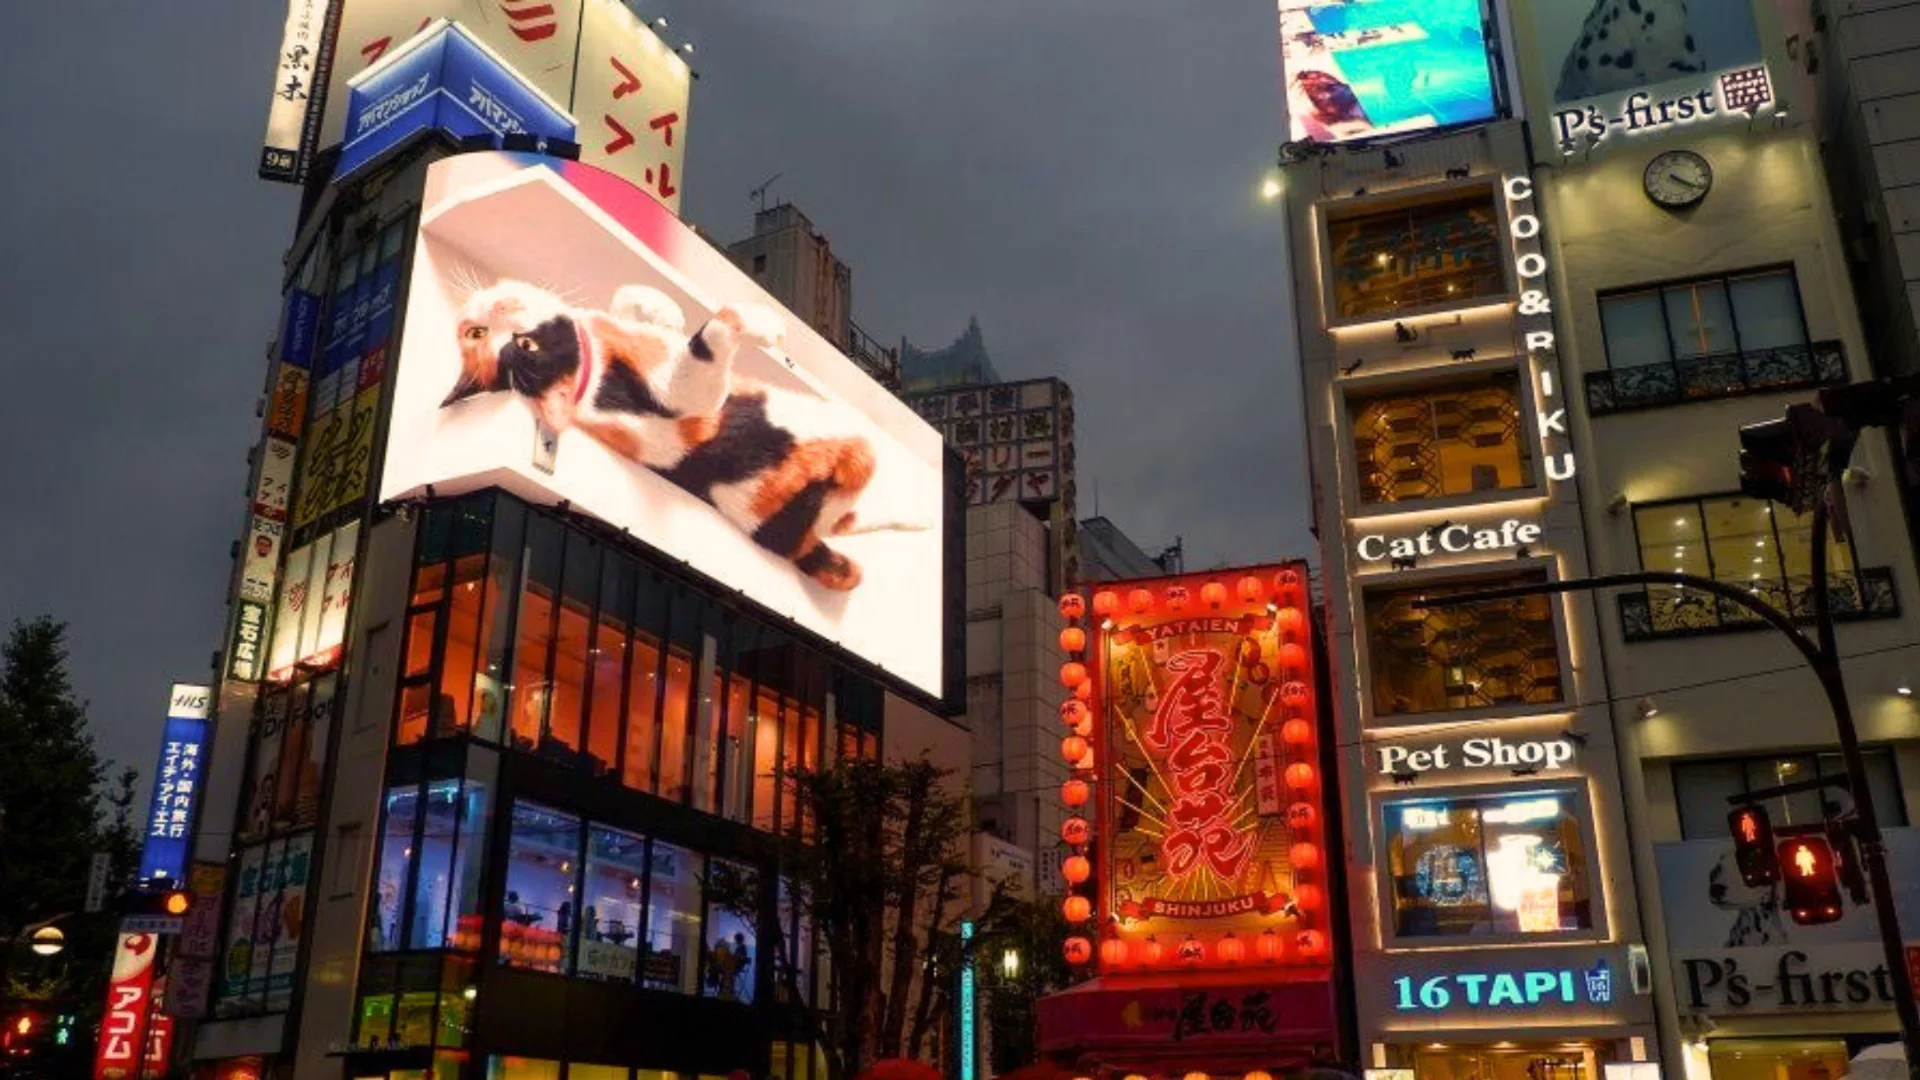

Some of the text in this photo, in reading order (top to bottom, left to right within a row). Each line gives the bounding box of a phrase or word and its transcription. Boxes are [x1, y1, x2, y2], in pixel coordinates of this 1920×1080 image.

[1357, 518, 1542, 563] Cat Cafe
[1145, 618, 1240, 641] YATAIEN
[1377, 737, 1573, 774] Pet Shop
[1153, 896, 1255, 917] SHINJUKU
[1393, 969, 1575, 1010] 16 TAPI
[1681, 950, 1894, 1012] P's-first
[104, 986, 142, 1060] アコム
